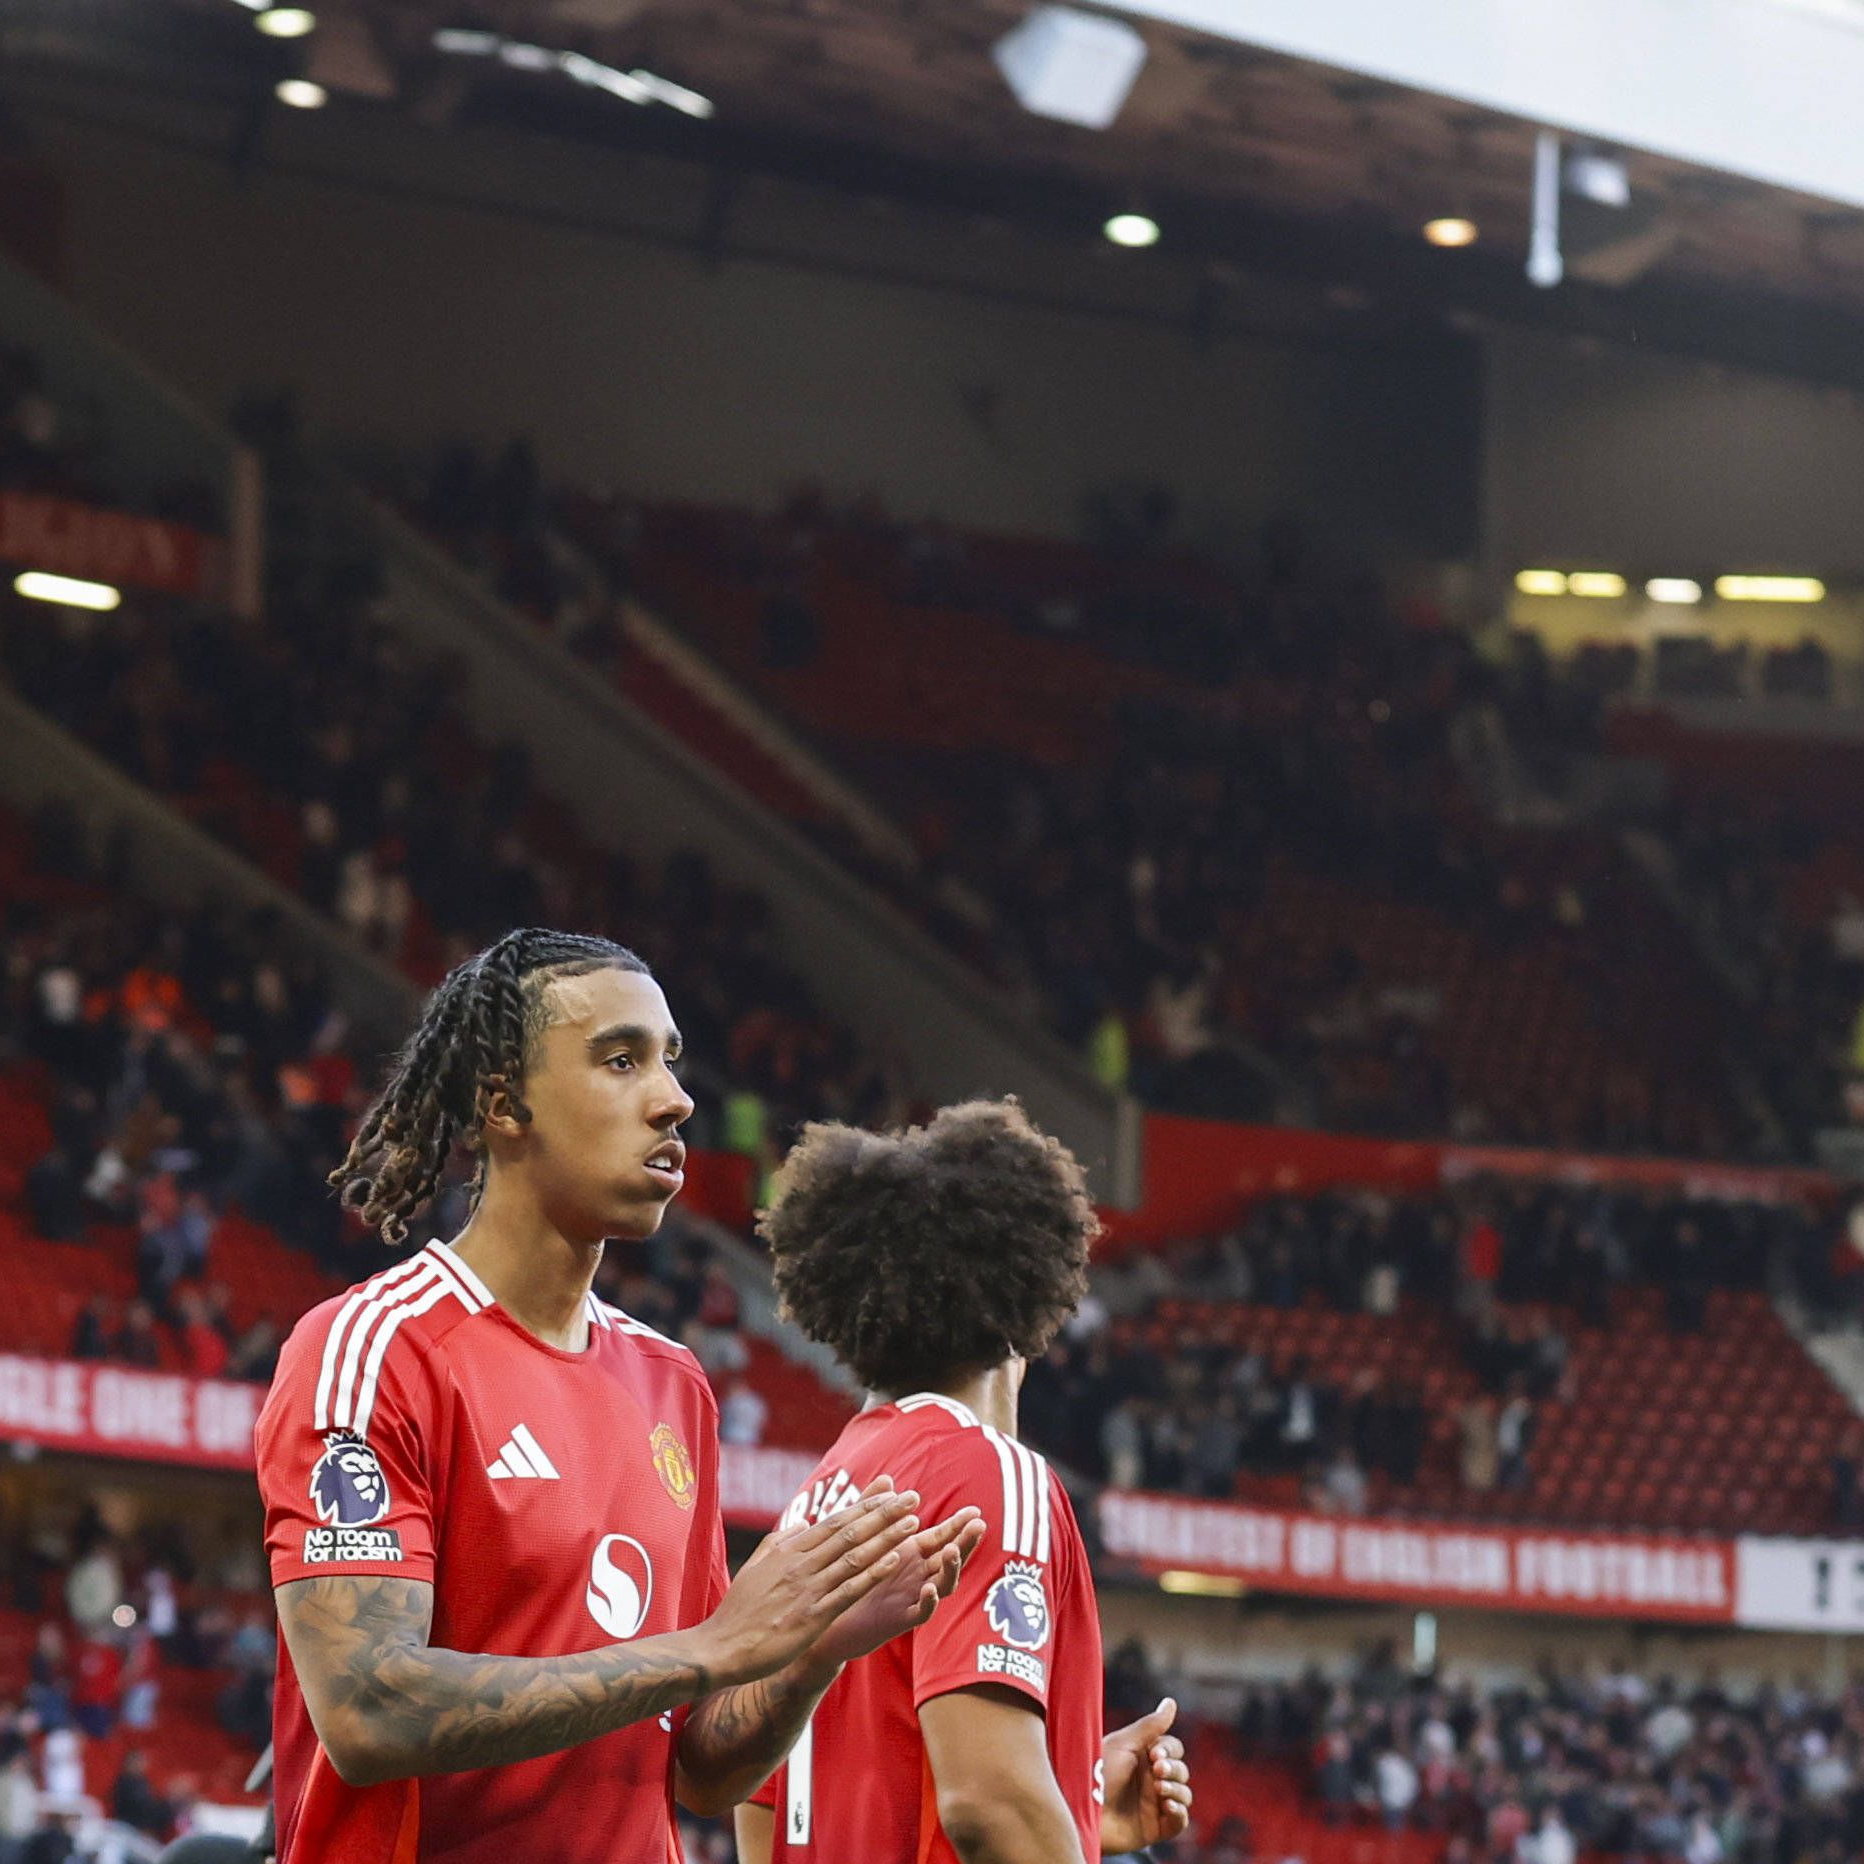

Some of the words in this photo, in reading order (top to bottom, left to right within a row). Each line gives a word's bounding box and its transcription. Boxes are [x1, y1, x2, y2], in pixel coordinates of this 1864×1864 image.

[305, 1529, 334, 1546] No
[337, 1529, 392, 1546] room
[304, 1545, 333, 1563] for
[335, 1546, 403, 1562] racism
[978, 1644, 1005, 1660] No
